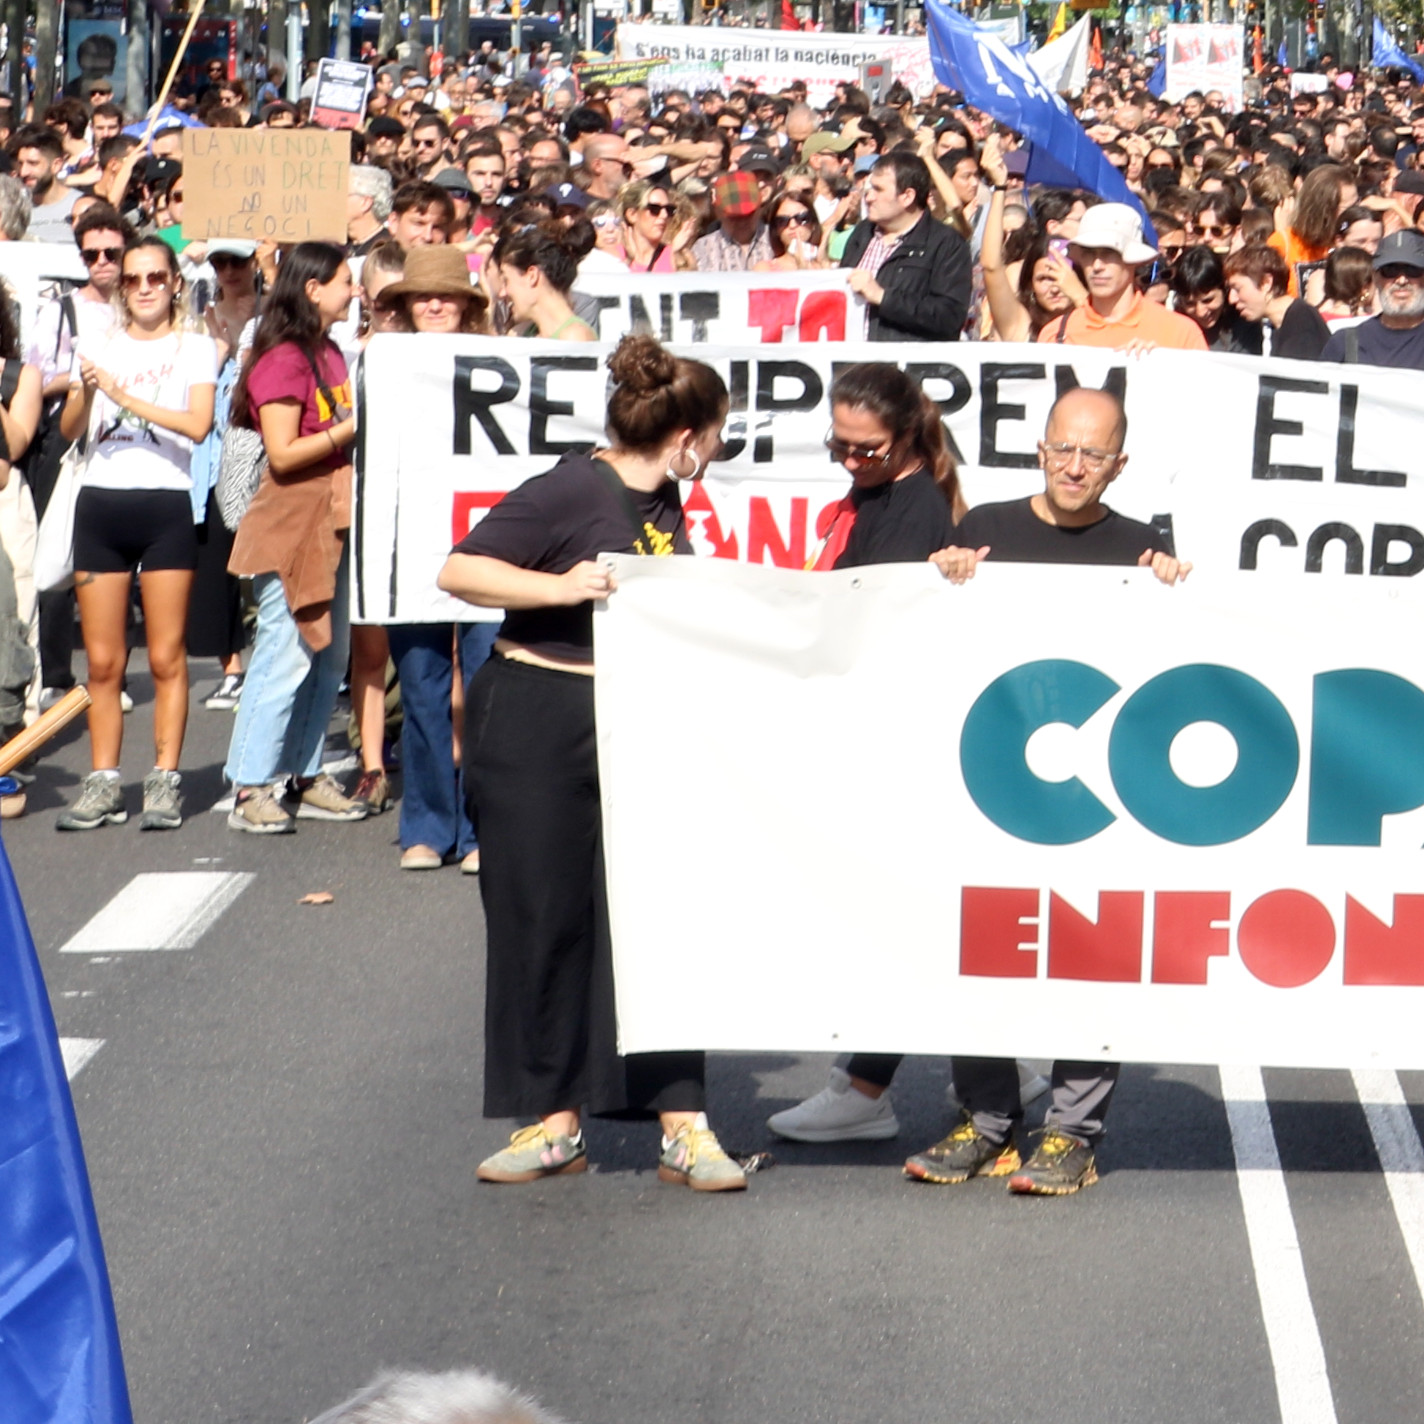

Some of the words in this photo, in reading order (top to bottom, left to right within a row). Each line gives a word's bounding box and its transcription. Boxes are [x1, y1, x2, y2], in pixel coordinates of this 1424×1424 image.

[192, 132, 221, 157] LA
[230, 134, 332, 158] VIVENDA
[244, 164, 265, 188] UN
[282, 161, 345, 191] DRET
[282, 194, 307, 213] UN
[206, 215, 312, 238] NEGOCI
[1251, 374, 1408, 488] EL
